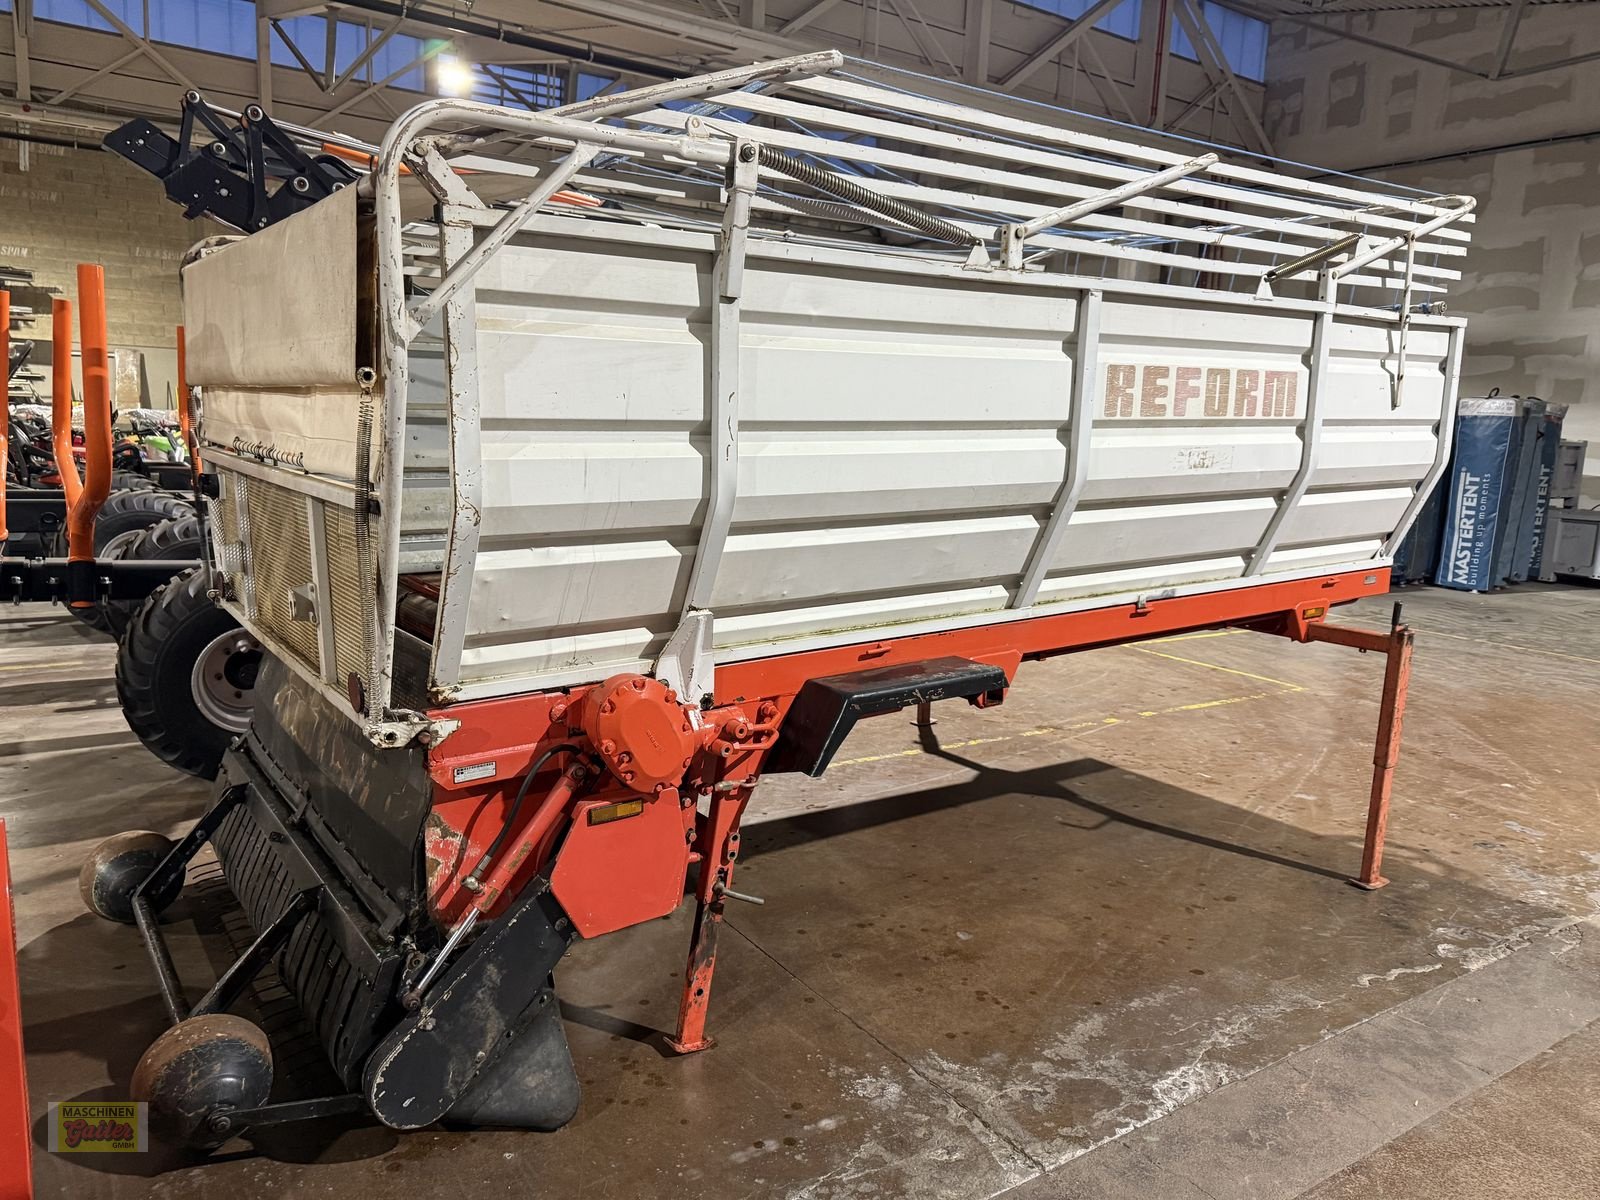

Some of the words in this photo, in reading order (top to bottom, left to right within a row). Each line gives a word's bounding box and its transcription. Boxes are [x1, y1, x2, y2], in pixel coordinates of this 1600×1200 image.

[1, 246, 28, 257] SPAN
[1103, 364, 1298, 417] REFORM
[1478, 473, 1491, 520] moments
[1453, 472, 1481, 585] MASTERTENT
[1477, 524, 1486, 537] up
[1468, 541, 1484, 586] building
